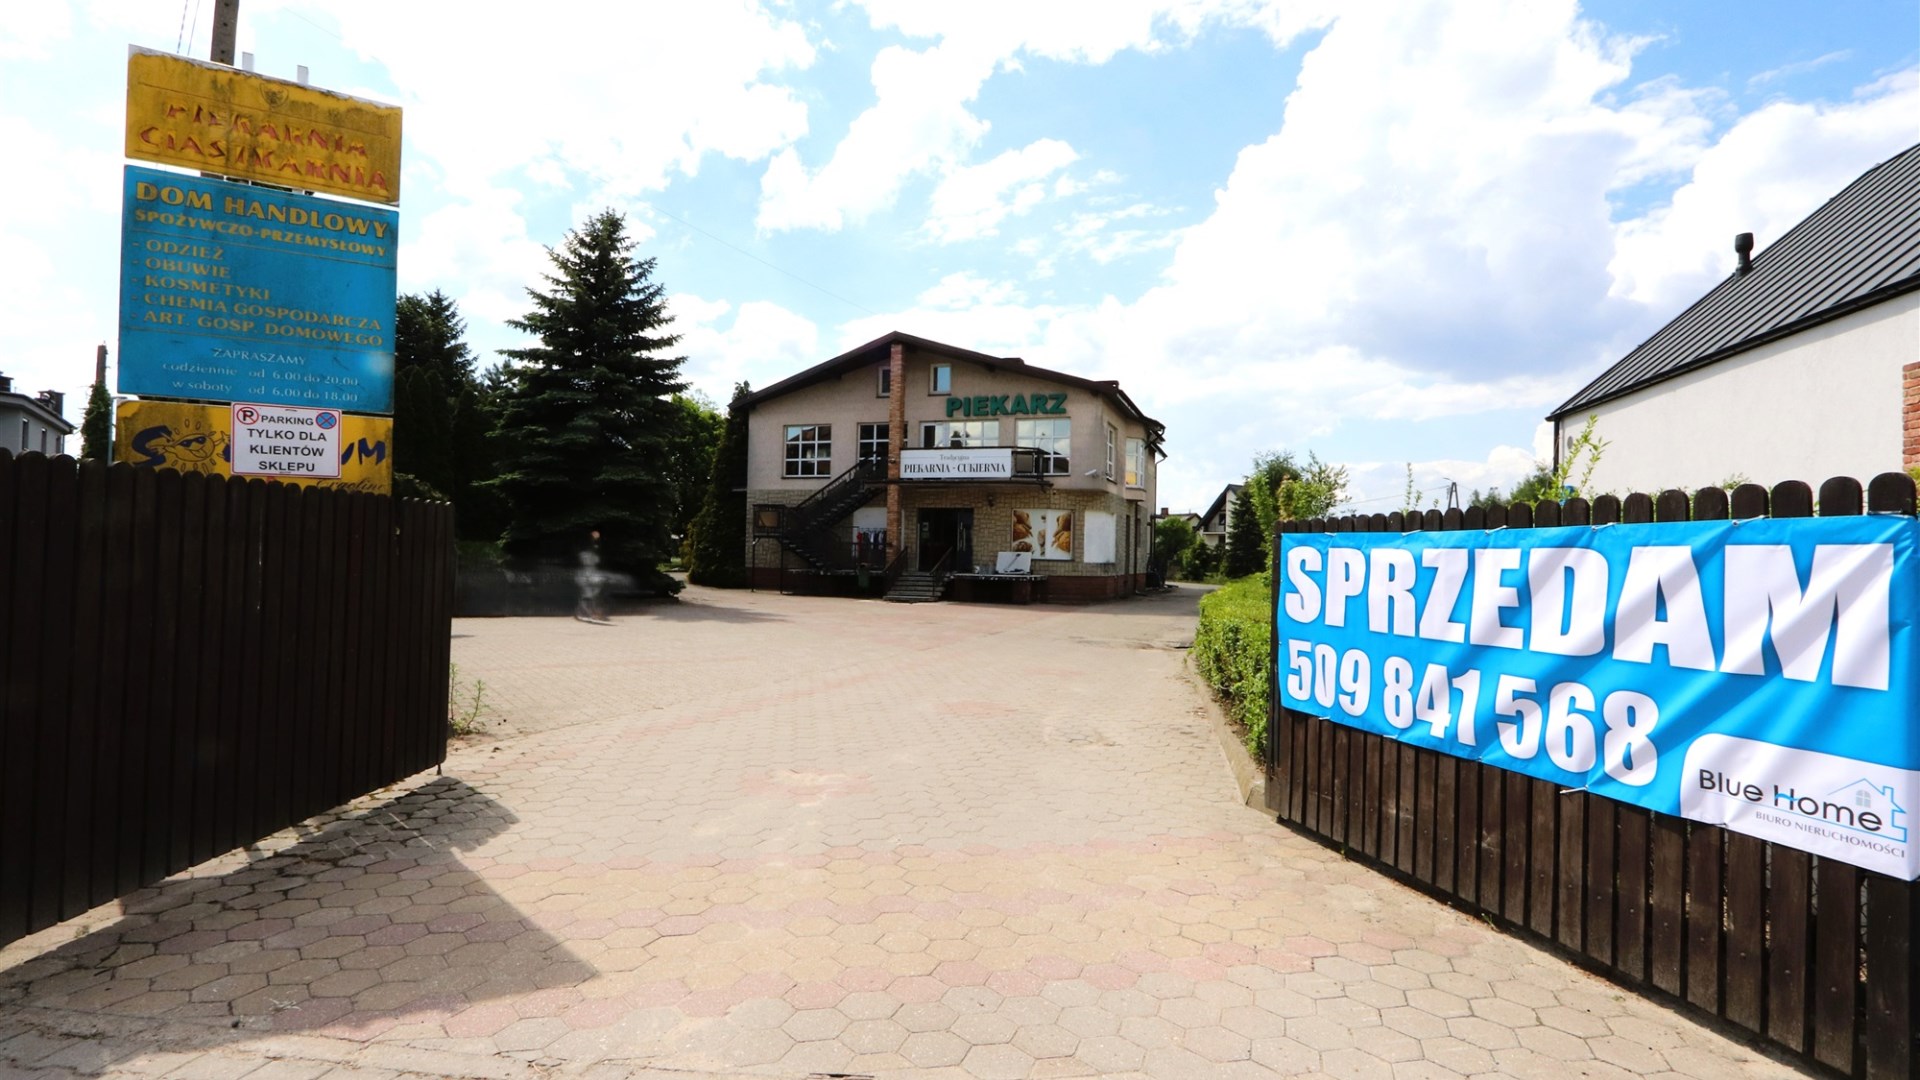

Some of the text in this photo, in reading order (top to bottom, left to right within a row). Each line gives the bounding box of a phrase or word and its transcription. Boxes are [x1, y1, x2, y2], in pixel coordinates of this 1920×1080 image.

[136, 181, 388, 239] DOM HANDLOWY
[145, 239, 224, 260] ODZIEŻ
[145, 256, 231, 278] OBUWIE
[144, 274, 270, 300] KOSMETYKI
[143, 292, 382, 331] CHEMIA GOSPODARCZA
[143, 310, 383, 347] ART. GOSP. DOMOWEGO
[213, 346, 306, 366] ZAPRASZAMY
[162, 361, 238, 376] codziennie
[248, 368, 265, 378] od
[272, 369, 301, 381] 6.00
[303, 372, 320, 383] do
[187, 381, 233, 395] soboty
[248, 385, 265, 395] od
[272, 386, 301, 398] 6.00
[303, 388, 320, 400] do
[945, 393, 1068, 418] PIEKARZ
[261, 415, 314, 426] PARKING
[246, 428, 327, 442] TYLKO DLA
[249, 444, 324, 457] KLIENTÓW
[258, 460, 315, 472] SKLEPU
[904, 464, 950, 473] PIEKARNIA
[957, 463, 1006, 473] CUKIERNIA
[1284, 543, 1895, 691] SPRZEDAM
[1287, 639, 1660, 787] 509 841 568
[1699, 768, 1883, 832] Blue Home
[1756, 810, 1905, 859] BIURO NIERUCHOMOŚCI
